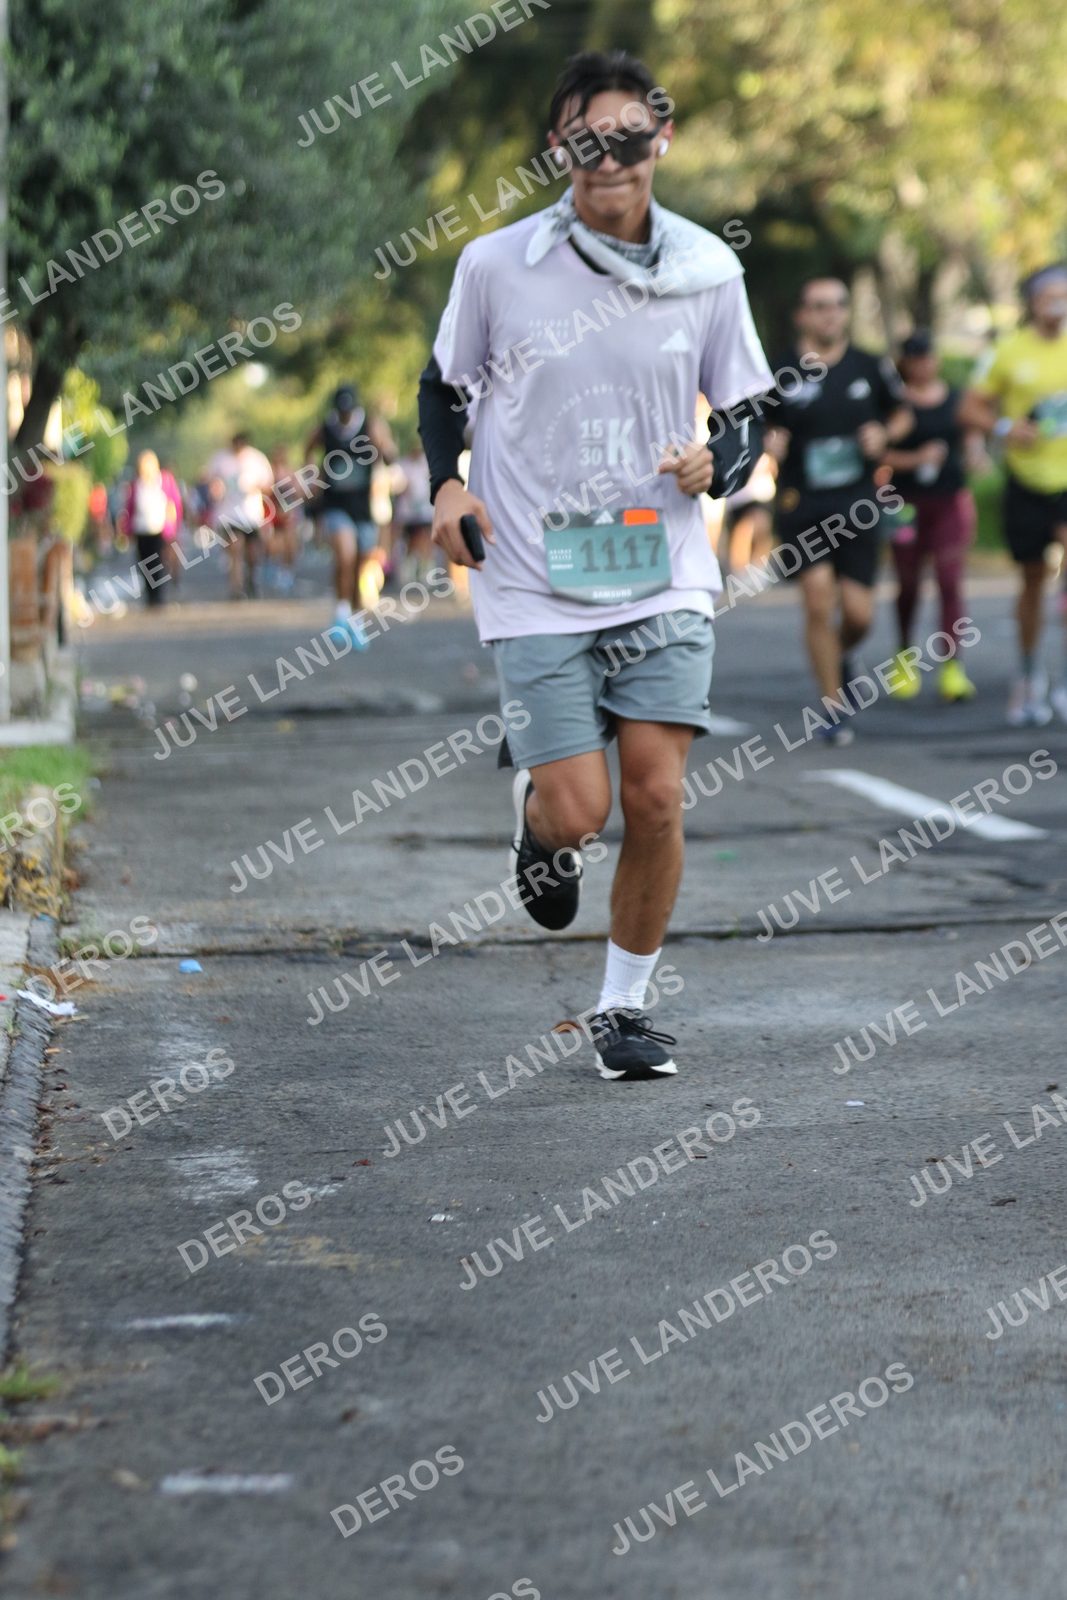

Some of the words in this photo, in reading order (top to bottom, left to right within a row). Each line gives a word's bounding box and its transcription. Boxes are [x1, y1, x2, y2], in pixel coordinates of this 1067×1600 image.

[580, 418, 603, 439] 15
[607, 417, 636, 466] K
[579, 446, 604, 467] 30
[580, 534, 662, 573] 1117
